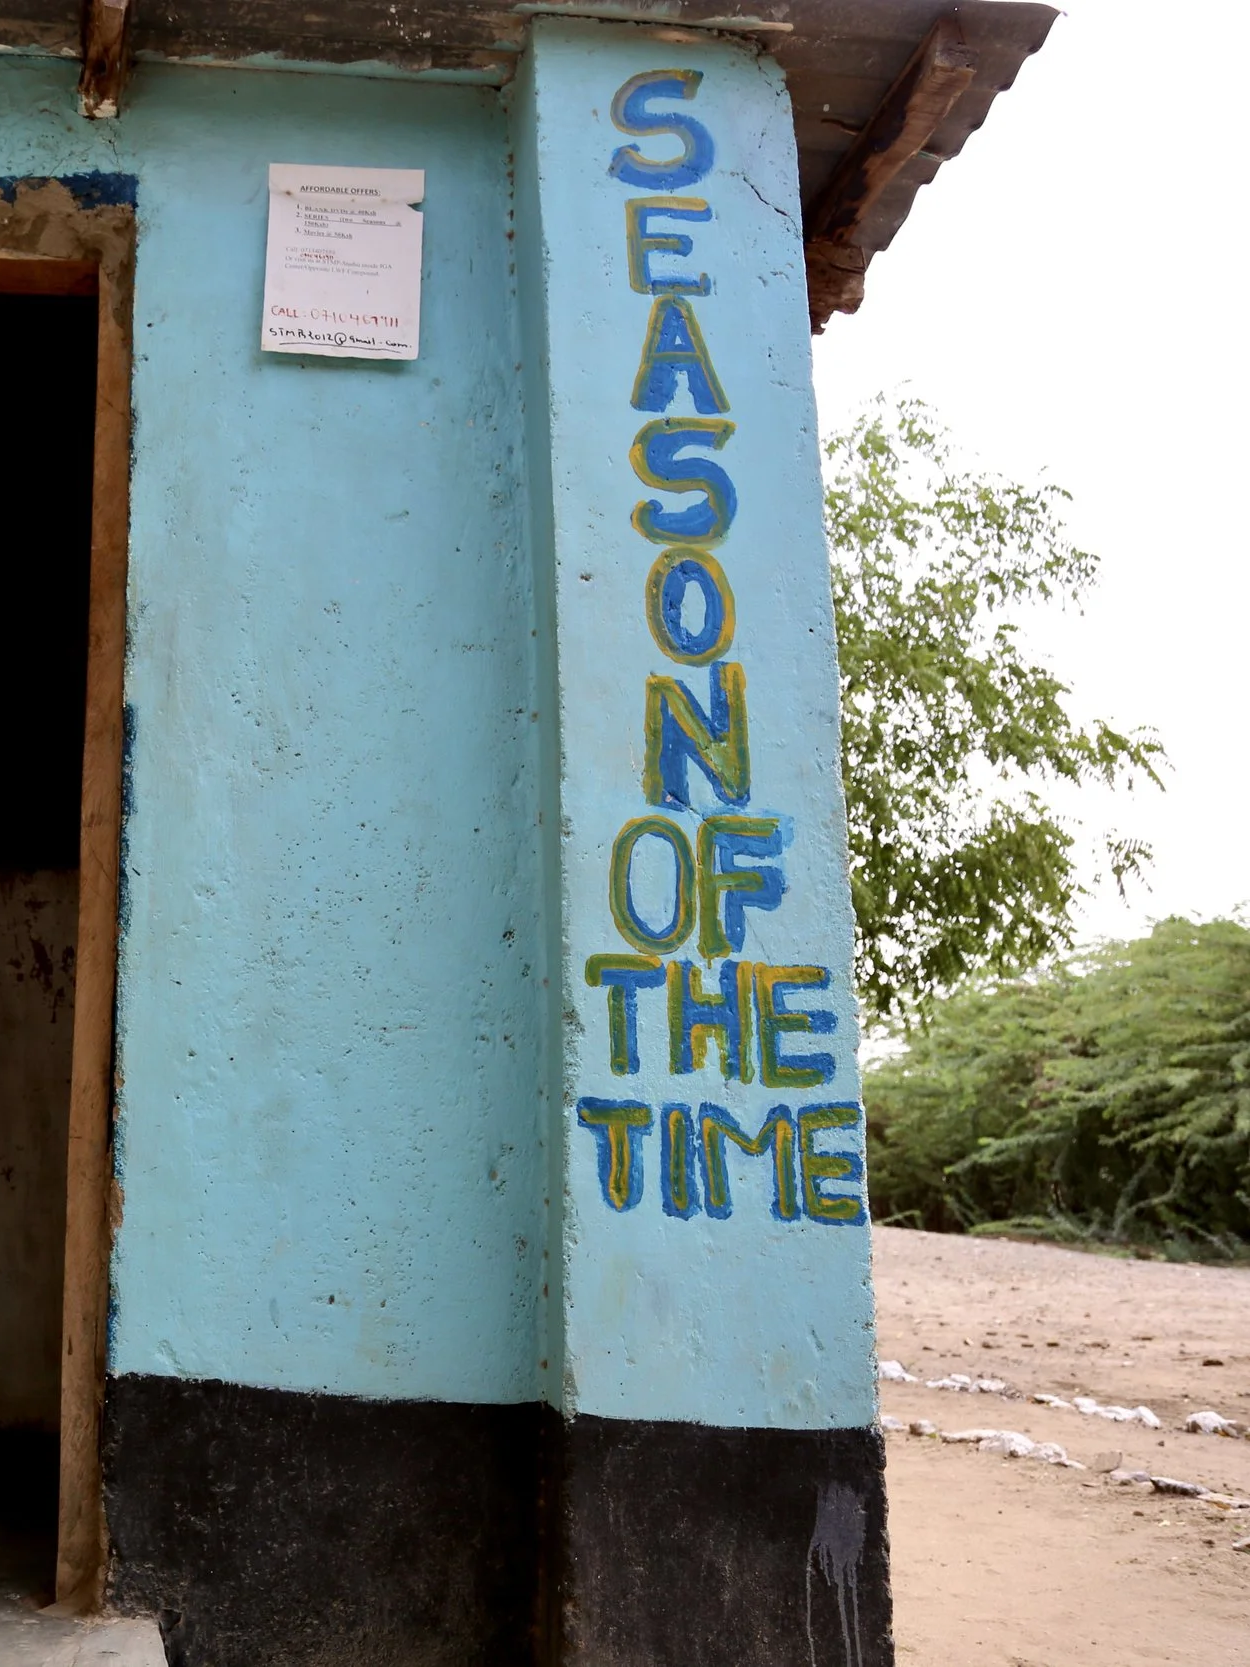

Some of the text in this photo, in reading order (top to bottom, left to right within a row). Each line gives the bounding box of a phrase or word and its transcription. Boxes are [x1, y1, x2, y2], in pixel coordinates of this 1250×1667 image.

[300, 185, 348, 195] AFFORDABLE
[303, 229, 325, 237] Movies
[304, 213, 329, 221] SERIES
[608, 69, 751, 812] SEASON
[609, 810, 793, 962] OF
[585, 952, 836, 1089] THE
[576, 1097, 867, 1225] TIME
